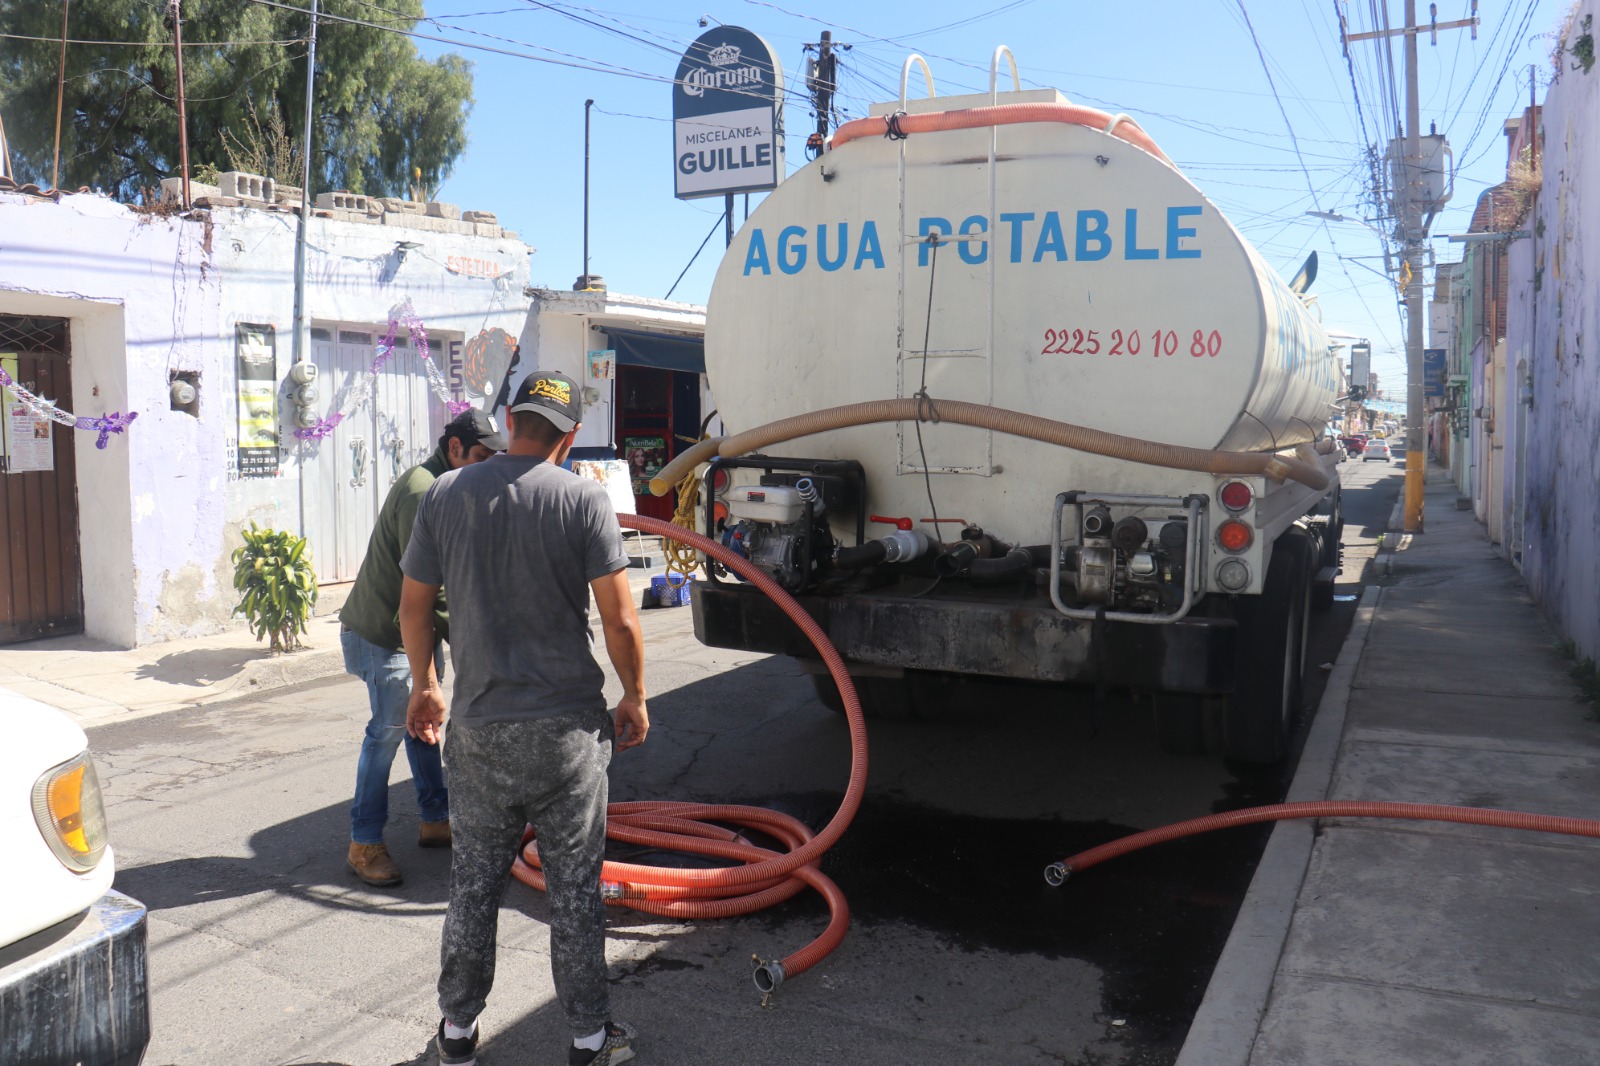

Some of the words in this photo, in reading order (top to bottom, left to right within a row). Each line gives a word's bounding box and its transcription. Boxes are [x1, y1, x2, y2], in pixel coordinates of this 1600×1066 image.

[683, 66, 762, 98] Corona
[685, 126, 762, 145] MISCELANEA
[679, 143, 771, 175] GUILLE
[743, 220, 885, 276] AGUA
[918, 205, 1203, 267] POTABLE
[447, 255, 501, 278] ESTETICA
[1041, 328, 1101, 355] 2225
[1108, 329, 1141, 356] 20
[1151, 329, 1179, 357] 10
[1190, 329, 1222, 357] 80
